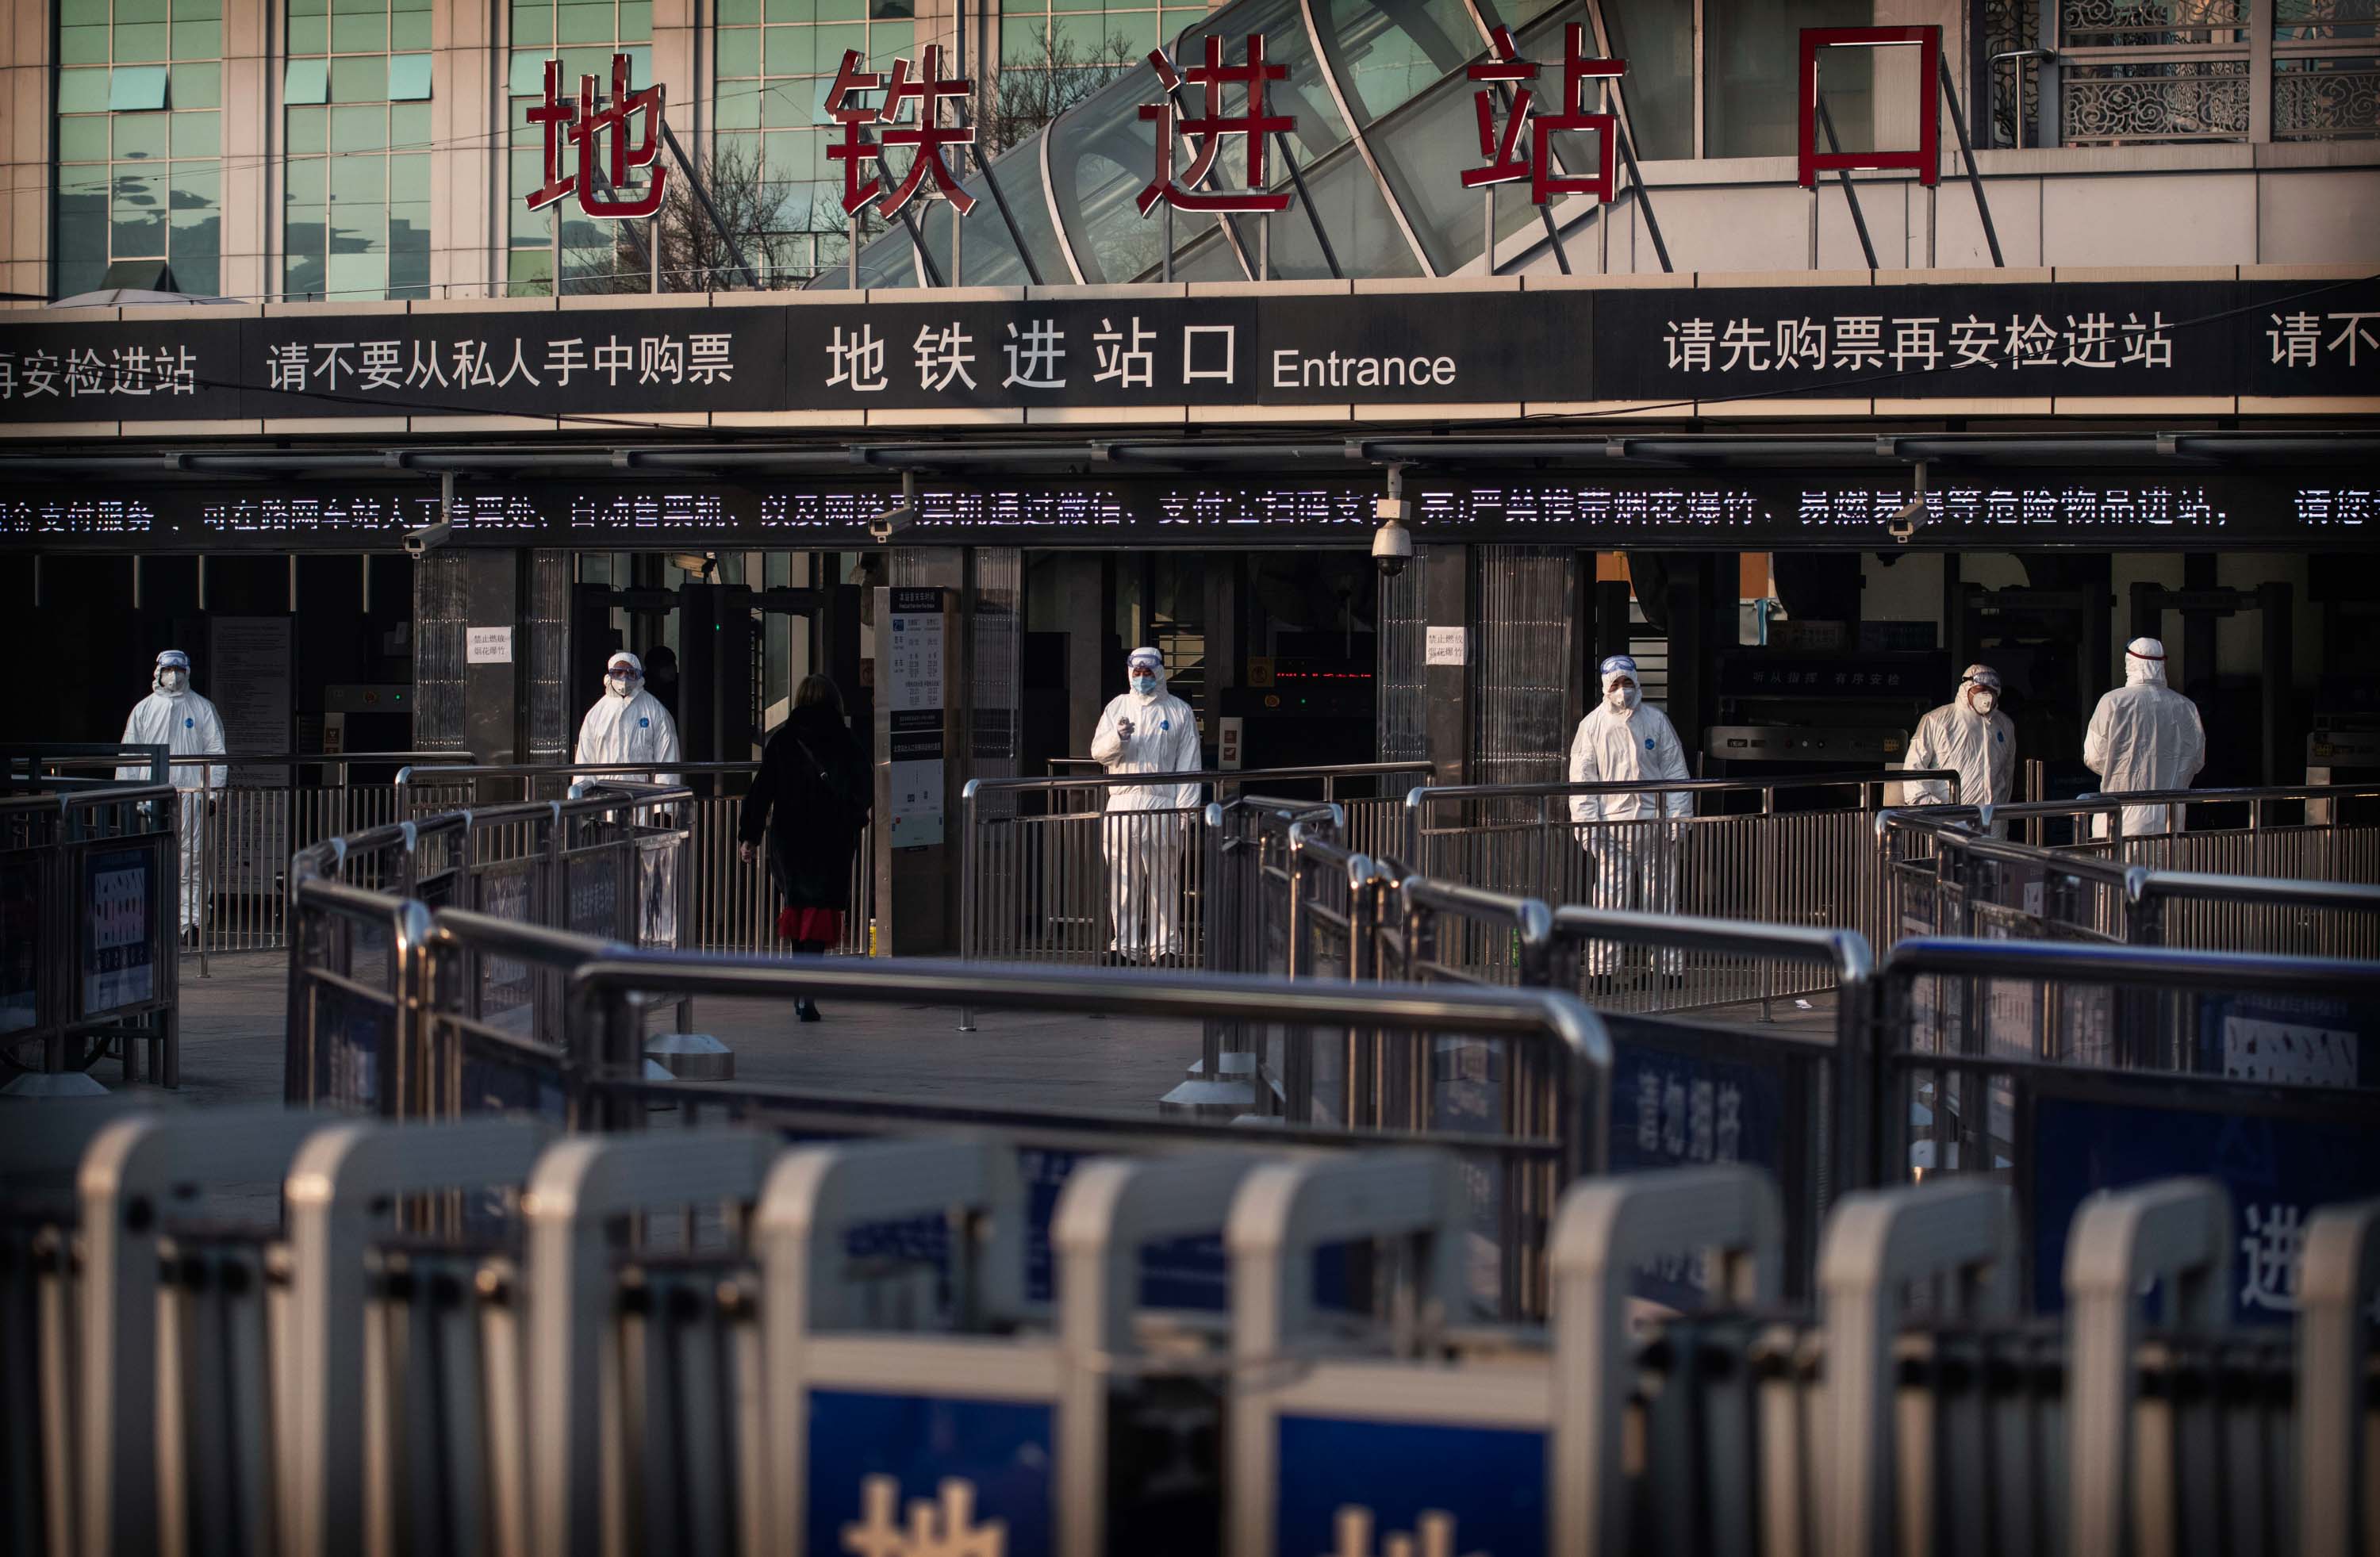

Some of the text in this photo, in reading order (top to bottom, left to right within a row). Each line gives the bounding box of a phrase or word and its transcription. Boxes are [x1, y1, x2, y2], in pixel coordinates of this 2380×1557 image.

[525, 23, 1941, 219] 地铁进站口
[267, 332, 734, 392] 请不要从私人手中购票
[825, 318, 1234, 391] 地铁进站口
[1273, 350, 1457, 387] Entrance
[1664, 312, 2175, 373] 请先购票再安检进站
[2267, 311, 2380, 368] 请不
